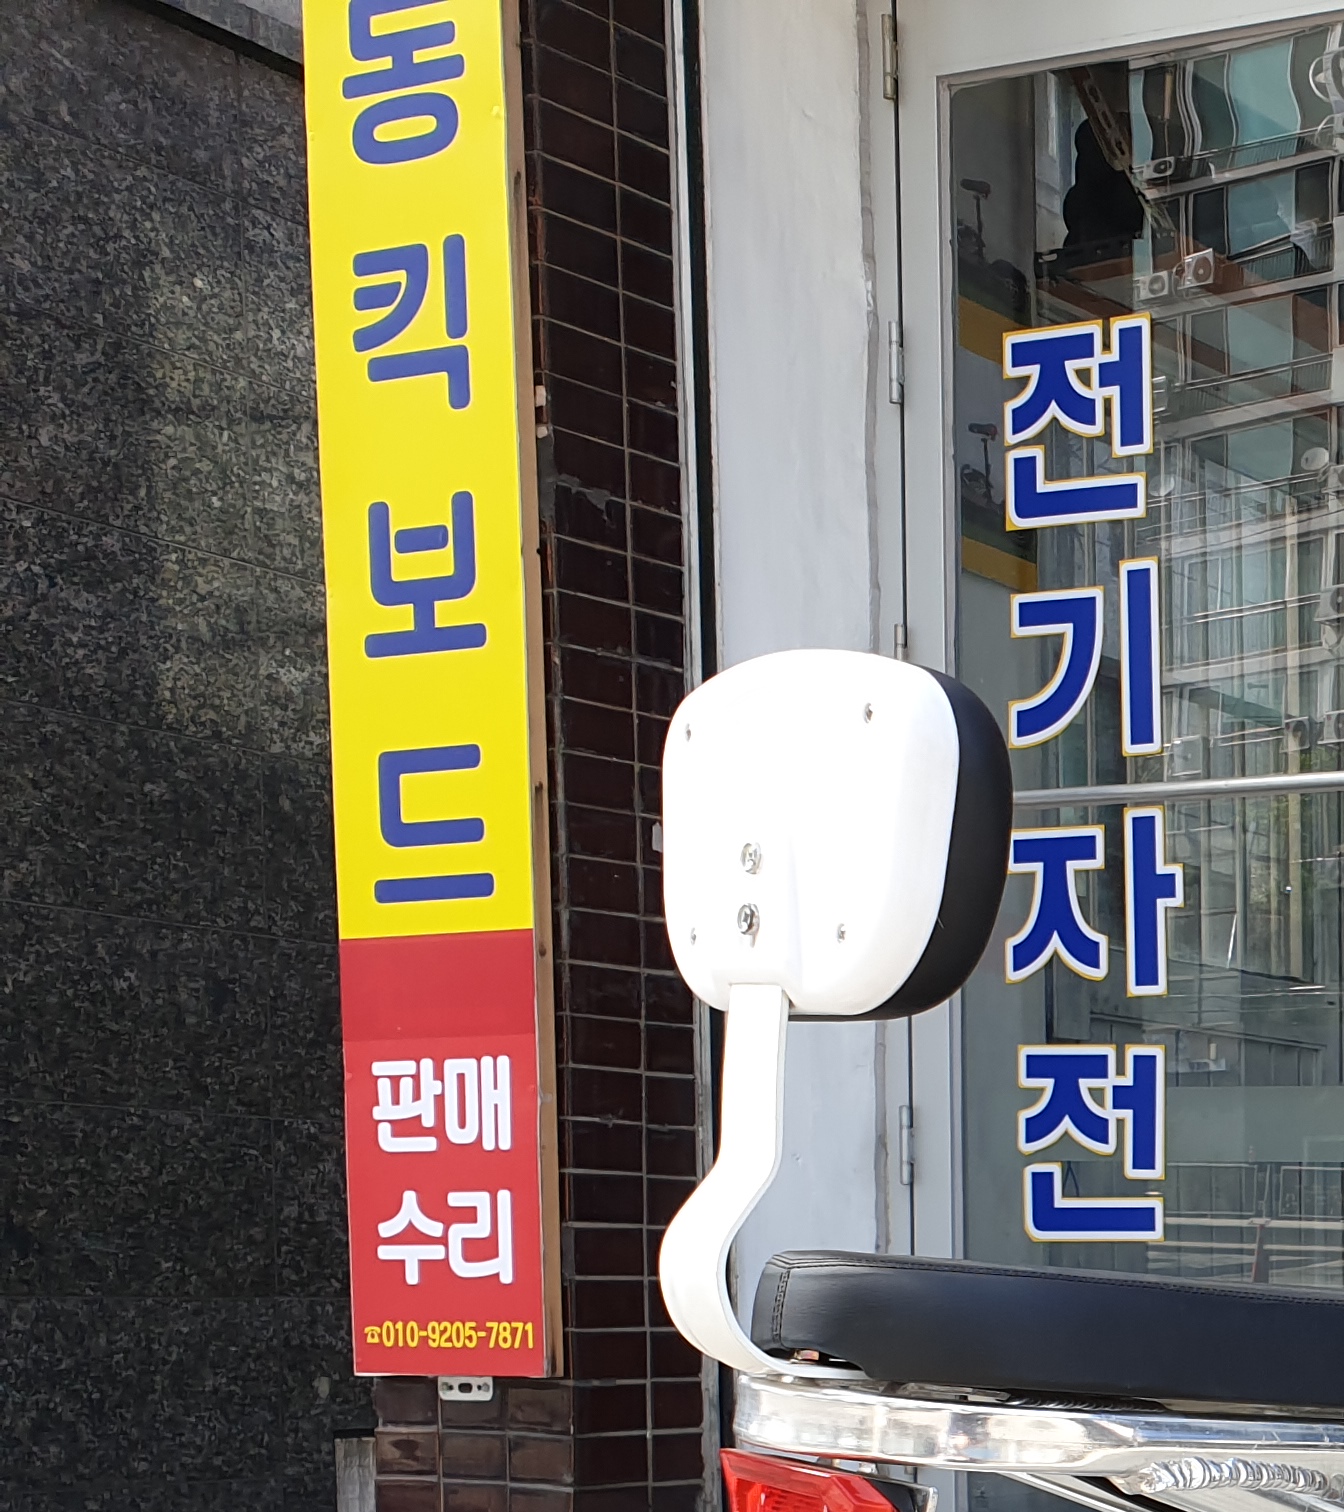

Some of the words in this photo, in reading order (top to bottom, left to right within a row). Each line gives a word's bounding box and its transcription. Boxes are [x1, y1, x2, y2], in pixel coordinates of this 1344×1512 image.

[371, 1054, 513, 1153] 판매
[376, 1188, 514, 1286] 수리
[381, 1320, 535, 1350] 010-9205-7871
